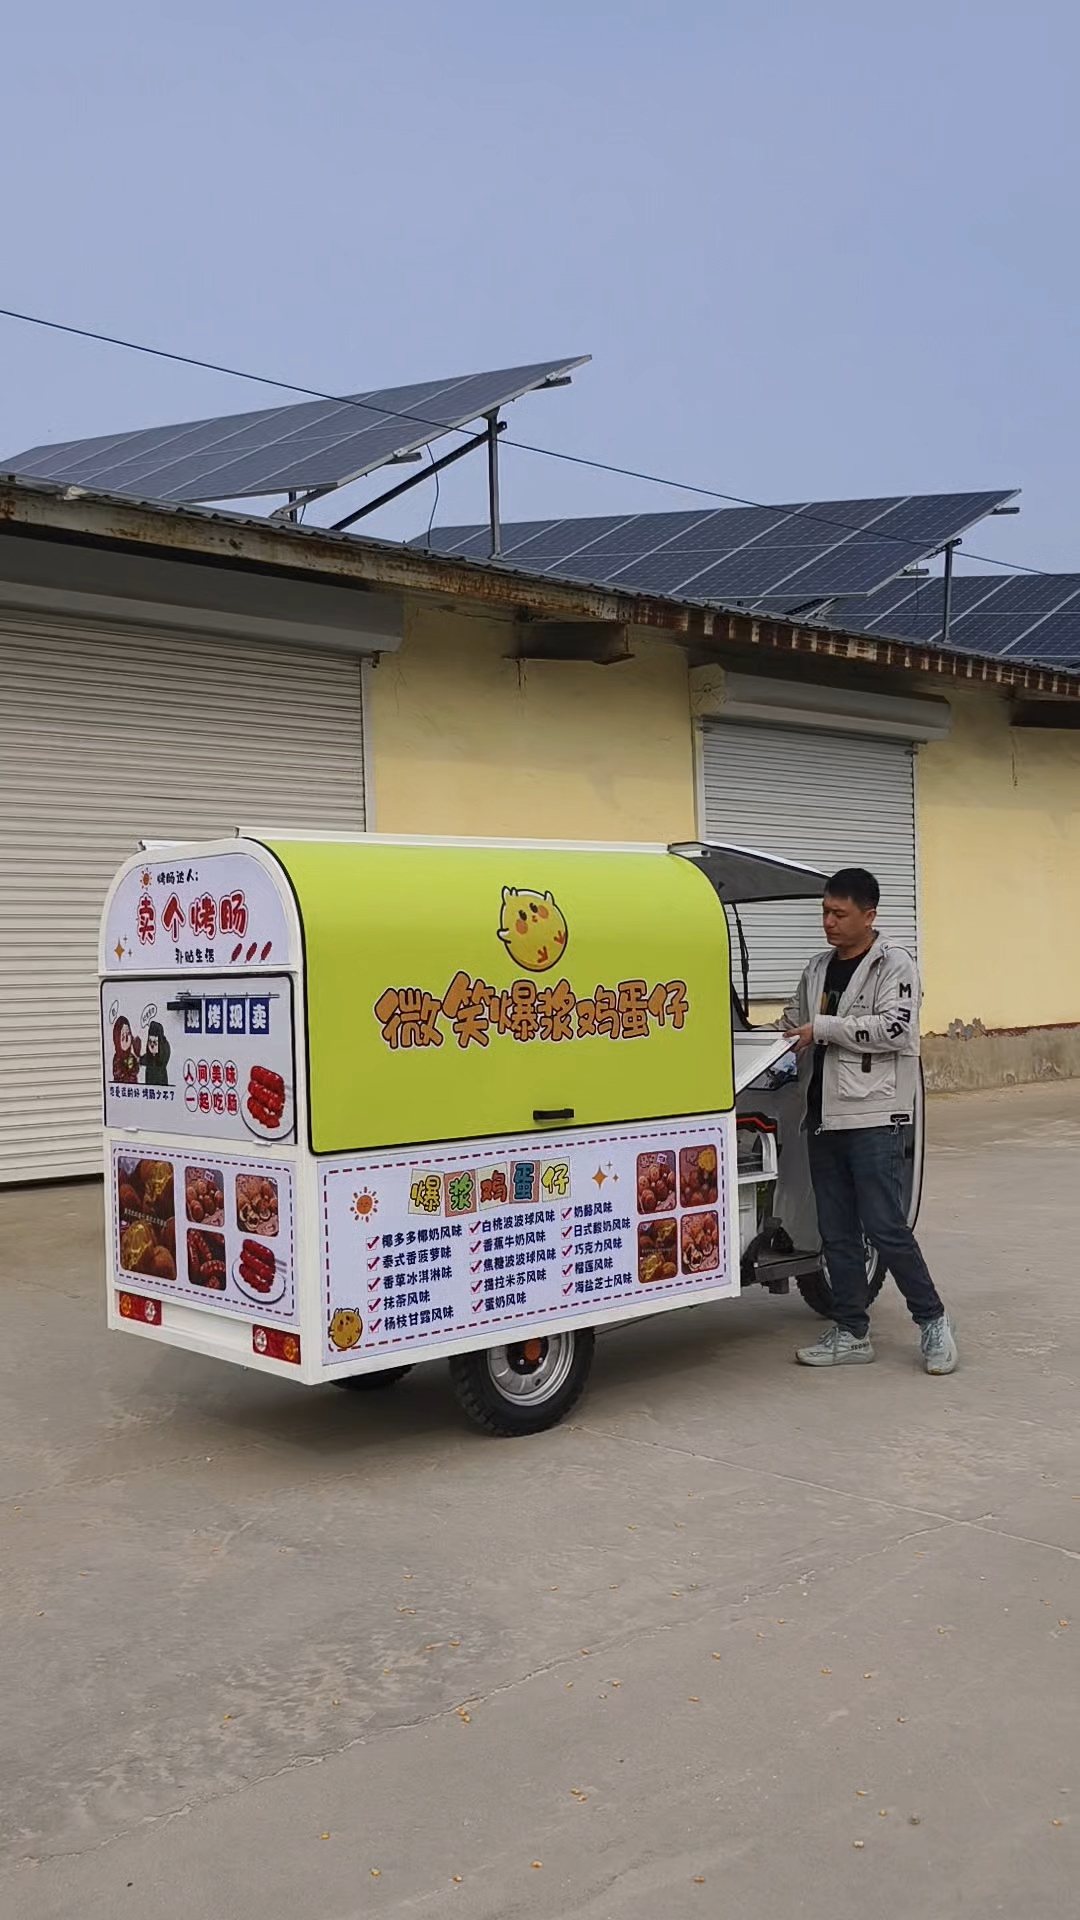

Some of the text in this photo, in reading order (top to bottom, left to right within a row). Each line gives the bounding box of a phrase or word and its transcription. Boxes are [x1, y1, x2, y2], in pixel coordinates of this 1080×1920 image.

[137, 889, 248, 946] 卖个烤肠
[373, 970, 690, 1049] 微笑爆浆鸡蛋仔
[184, 1062, 237, 1085] 人间美味
[410, 1162, 570, 1213] 爆浆鸡蛋仔
[482, 1209, 556, 1232] 白桃波波球风味
[574, 1217, 631, 1237] 日式酸奶风味
[483, 1230, 546, 1252] 香蕉牛奶风味
[574, 1236, 623, 1255] 巧克力风味
[483, 1248, 557, 1272] 焦糖波波球风味
[574, 1256, 614, 1275] 榴莲风味
[574, 1272, 633, 1294] 海盐芝士风味
[383, 1289, 431, 1310] 抹茶风味
[384, 1305, 455, 1331] 杨枝甘露风味
